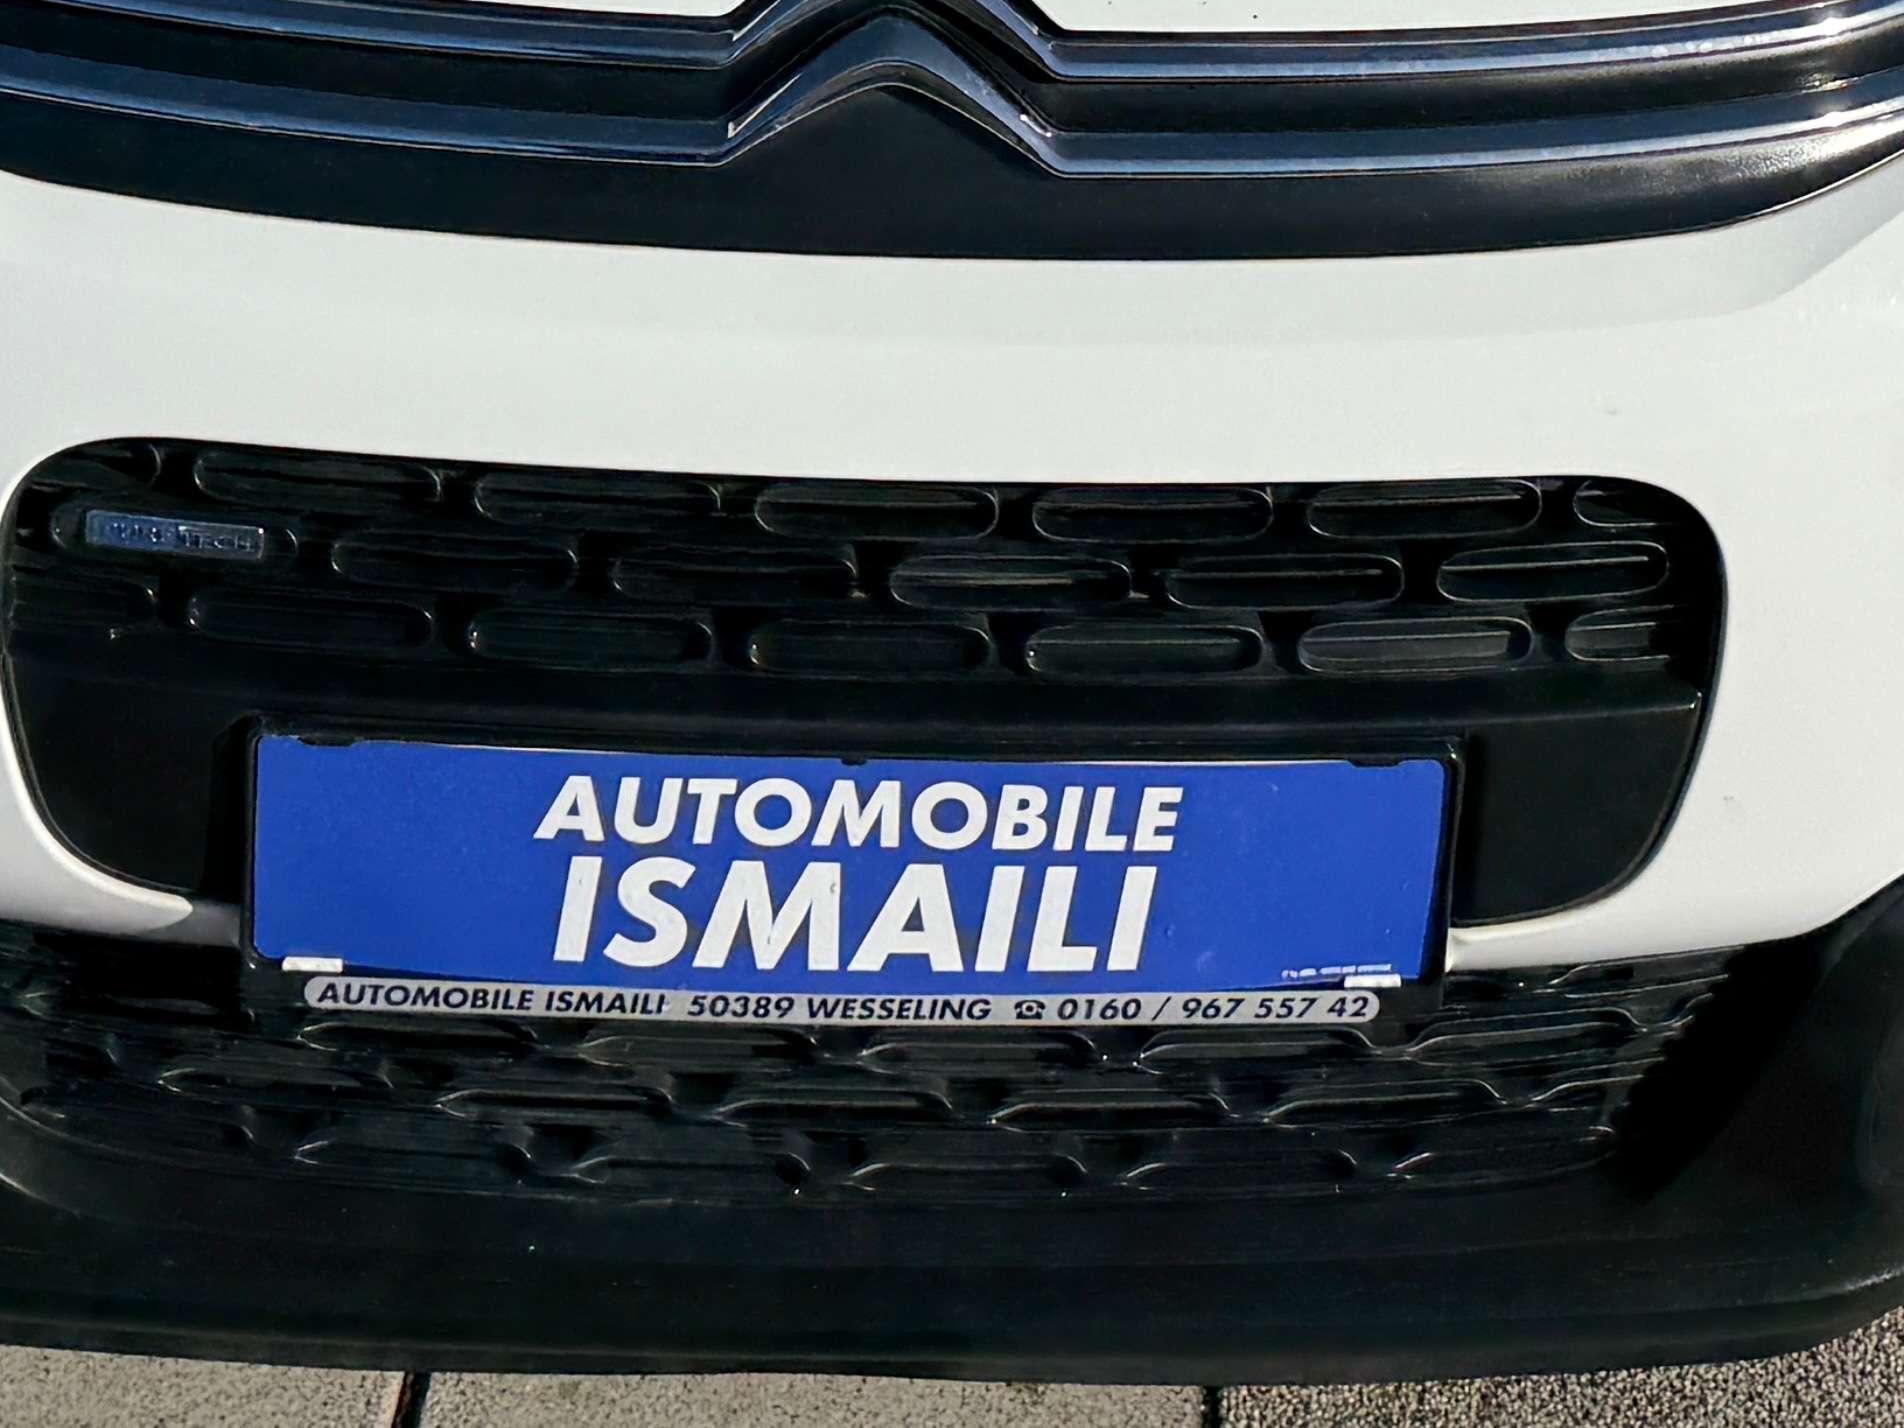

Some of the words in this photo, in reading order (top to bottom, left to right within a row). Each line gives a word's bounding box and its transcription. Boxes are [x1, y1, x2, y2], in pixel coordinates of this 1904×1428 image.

[533, 775, 1183, 852] AUTOMOBILE
[553, 855, 1157, 973] ISMAILI
[318, 981, 532, 1012] AUTOMOBILE
[545, 991, 666, 1016] ISMAILI
[687, 994, 795, 1019] 50389
[807, 996, 992, 1021] WESSELING
[1057, 997, 1142, 1021] 0160
[1152, 996, 1171, 1022] /
[1182, 997, 1243, 1021] 967
[1254, 996, 1319, 1020] 557
[1327, 995, 1370, 1019] 42
